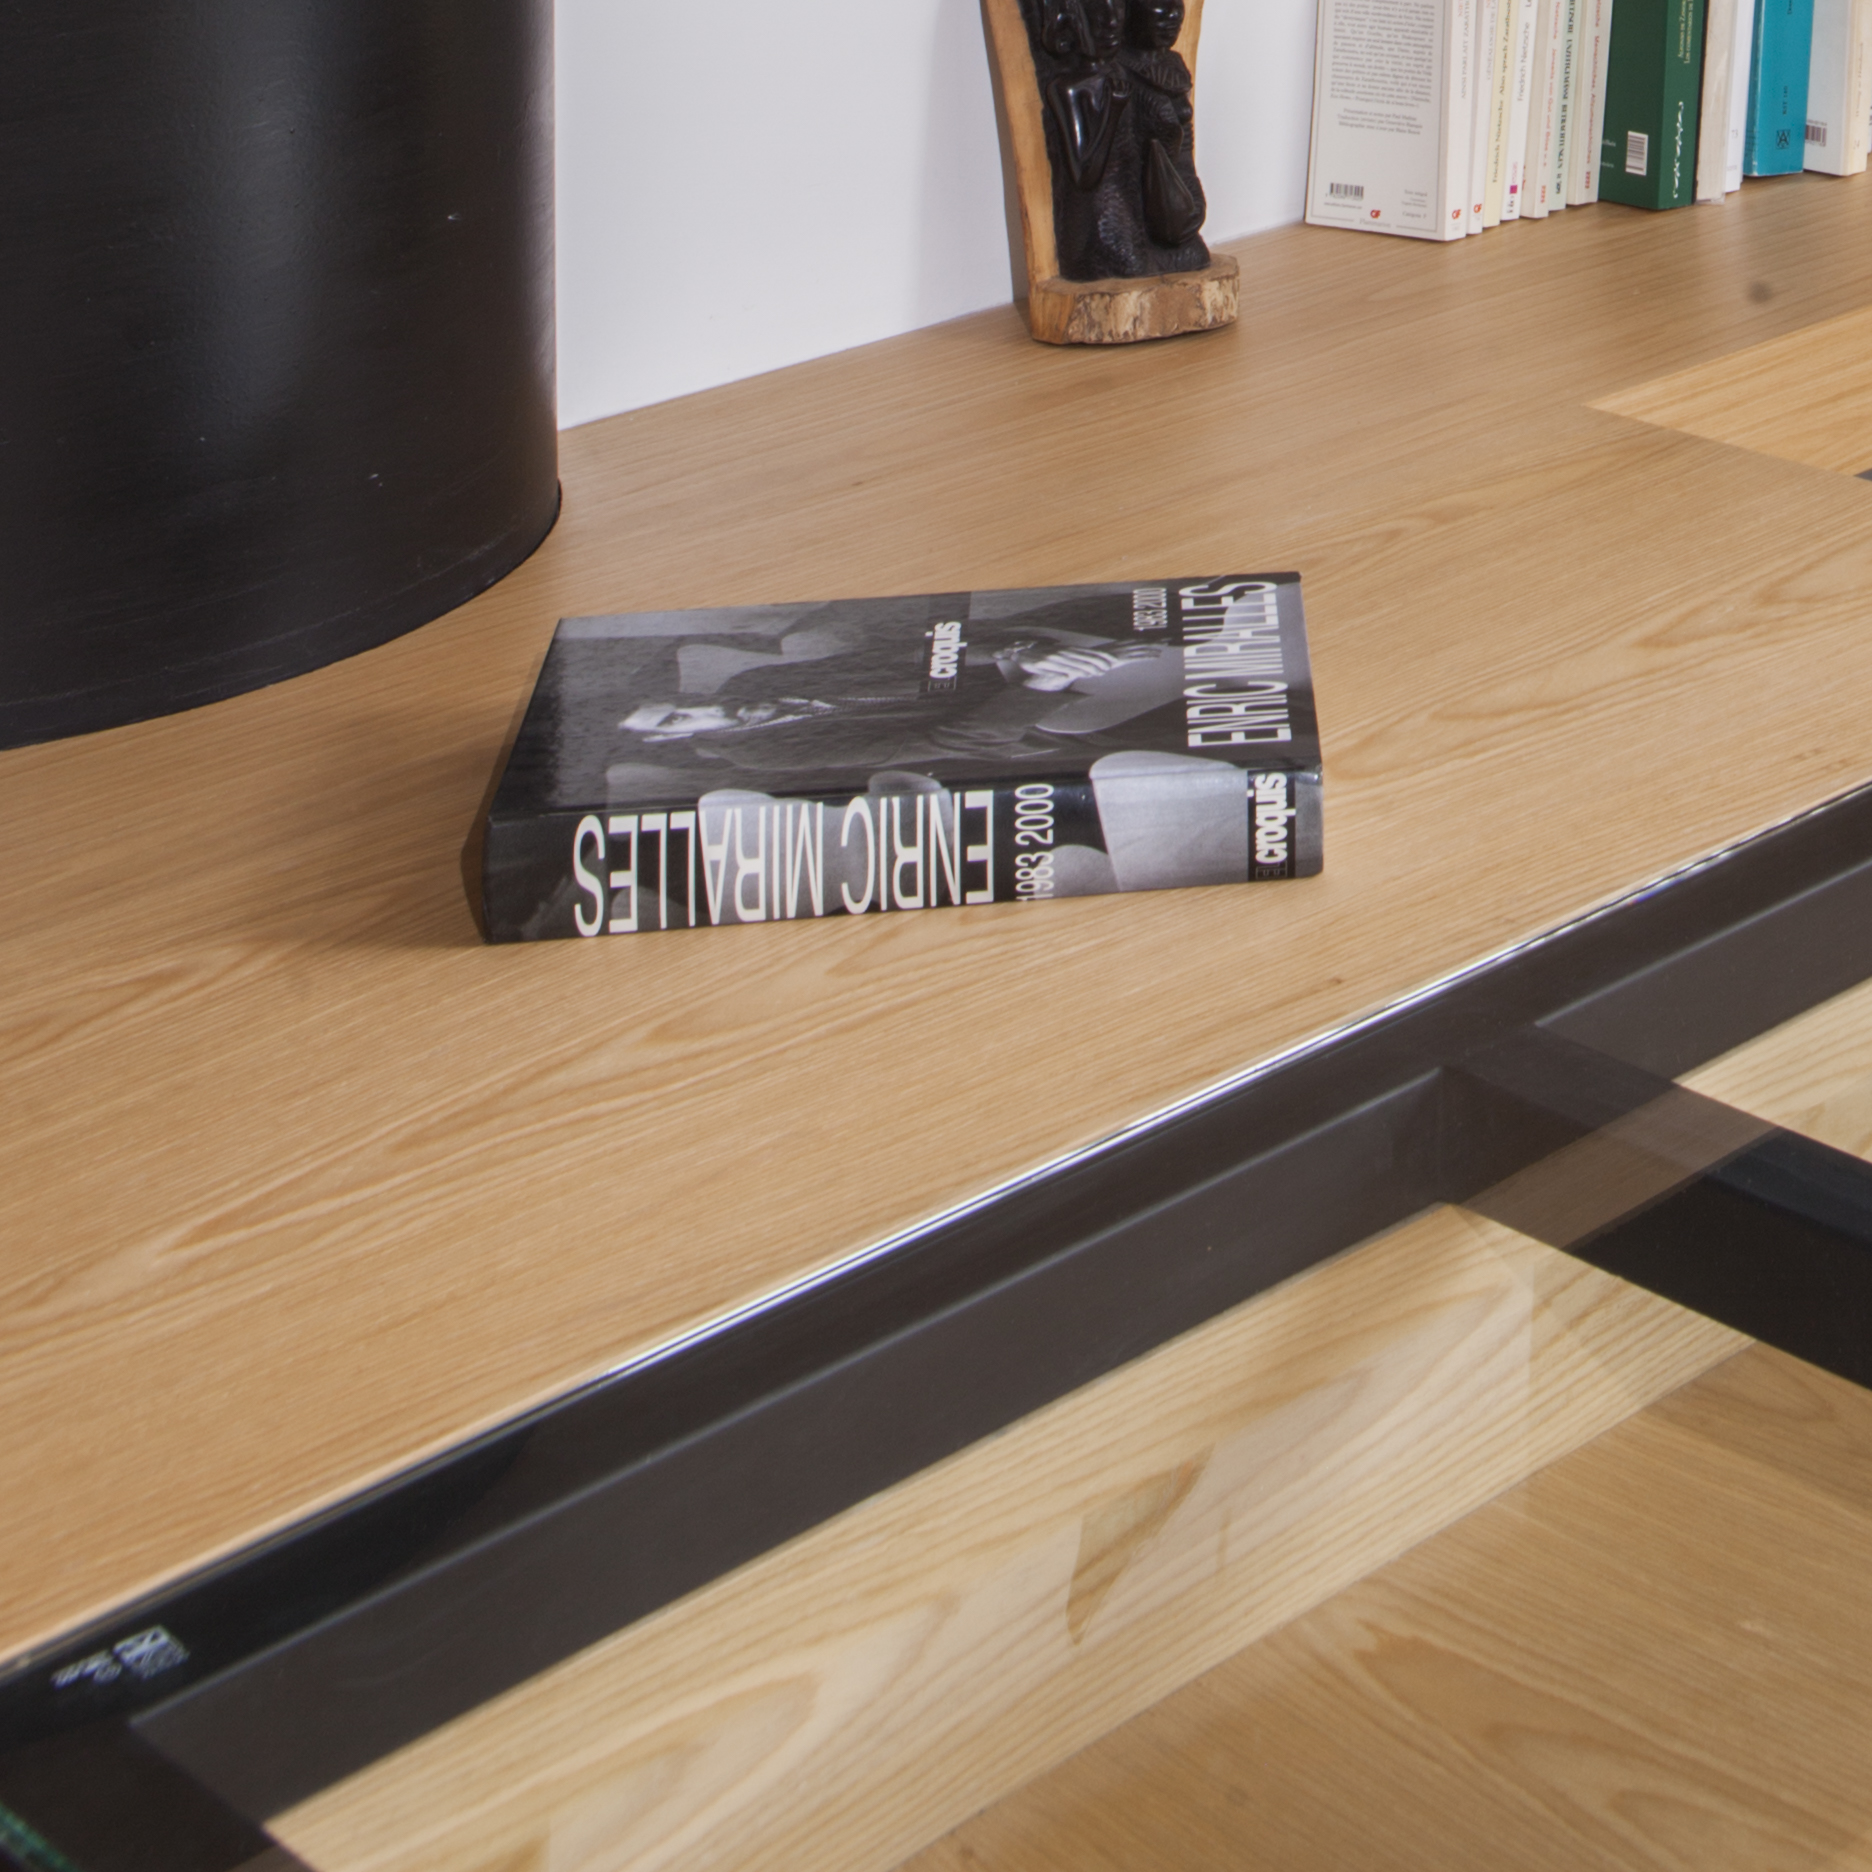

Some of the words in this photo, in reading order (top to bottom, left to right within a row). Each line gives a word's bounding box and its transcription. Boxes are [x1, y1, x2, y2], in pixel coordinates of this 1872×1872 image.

[1519, 22, 1530, 62] Nietzsche
[1516, 64, 1526, 102] Friedrich
[925, 620, 968, 680] croquis
[1178, 580, 1286, 680] MIRALLES
[1183, 679, 1292, 747] ENRIC
[1014, 783, 1055, 846] 2000
[1246, 772, 1297, 866] croquis
[573, 801, 825, 938] MIRALLES
[840, 789, 995, 916] ENRIC
[1014, 851, 1055, 903] 1983
